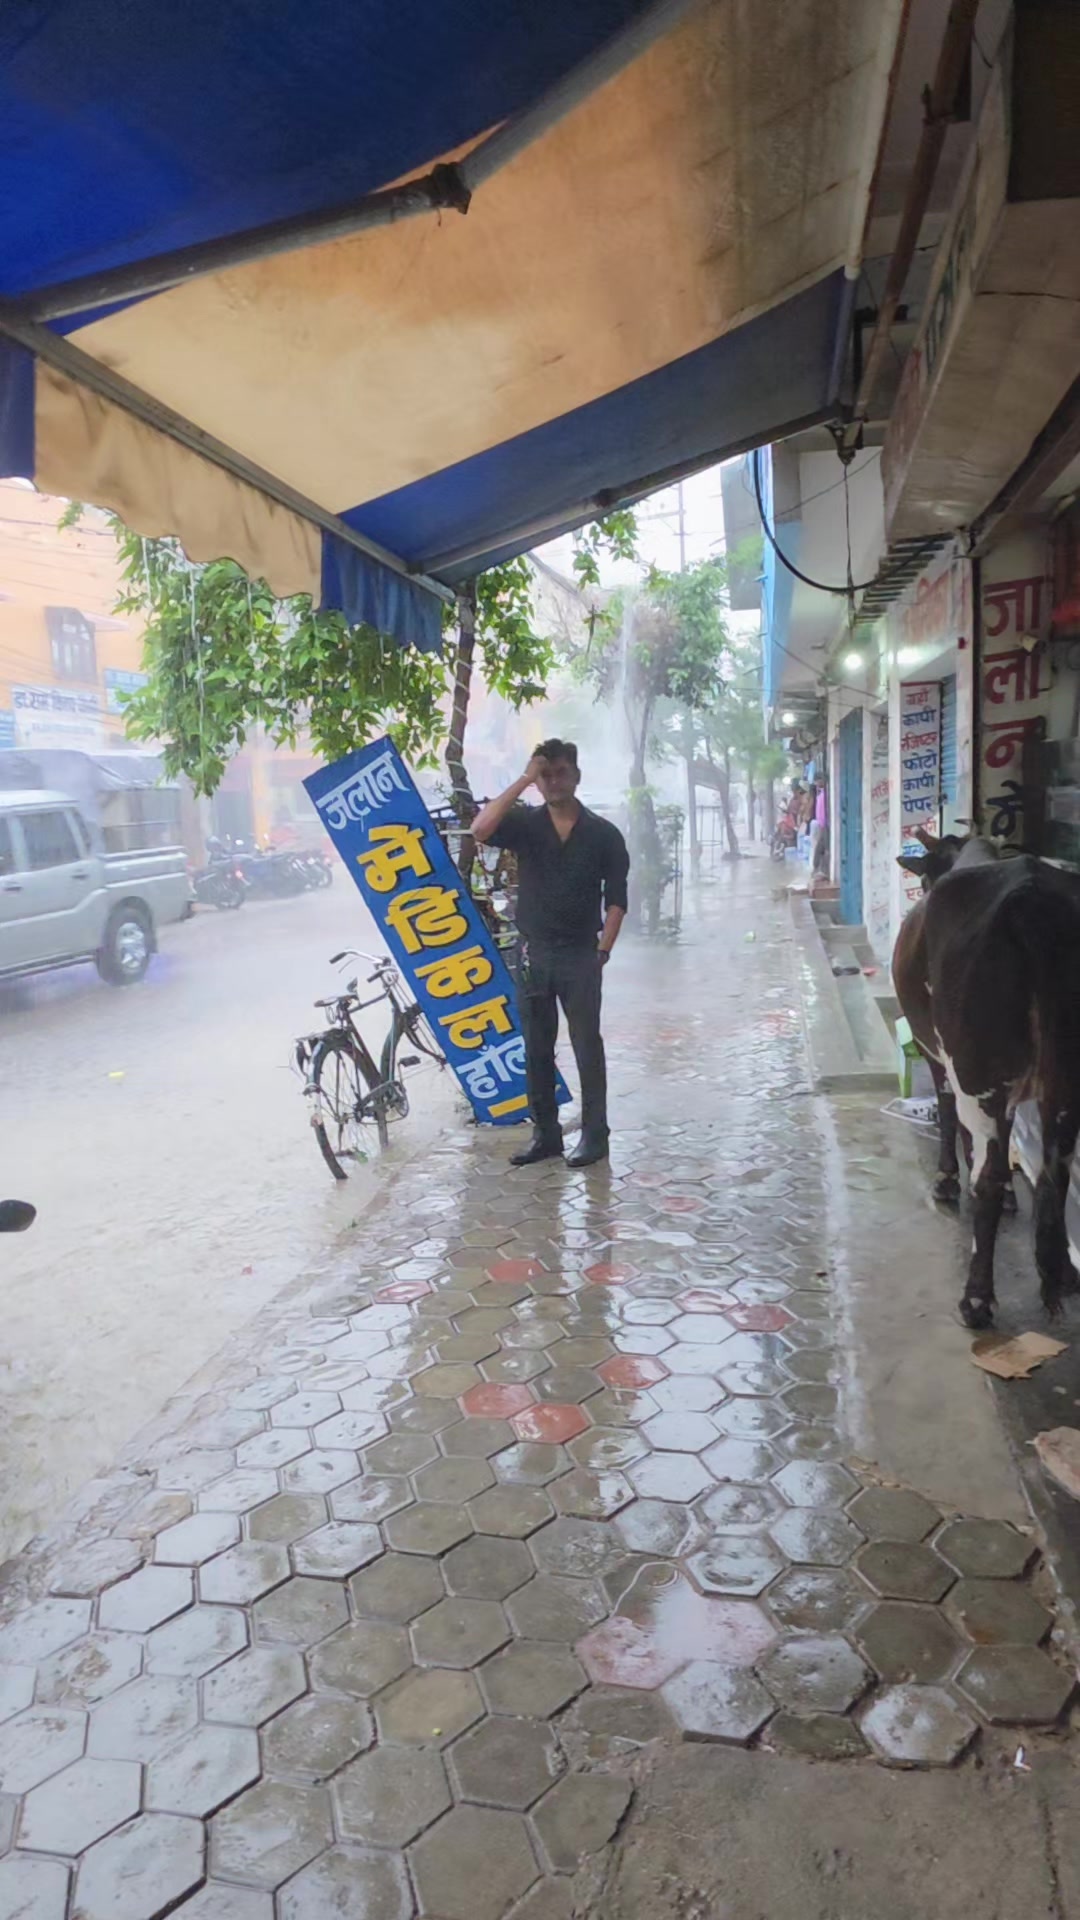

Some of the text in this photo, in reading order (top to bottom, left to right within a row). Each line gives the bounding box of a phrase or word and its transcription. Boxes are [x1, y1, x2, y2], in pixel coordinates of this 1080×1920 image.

[902, 705, 937, 726] कापी
[902, 749, 938, 771] फोटो
[315, 750, 411, 831] जलान
[902, 771, 936, 792] कापी
[902, 794, 934, 813] पेपर
[356, 822, 512, 1049] मेडिकल
